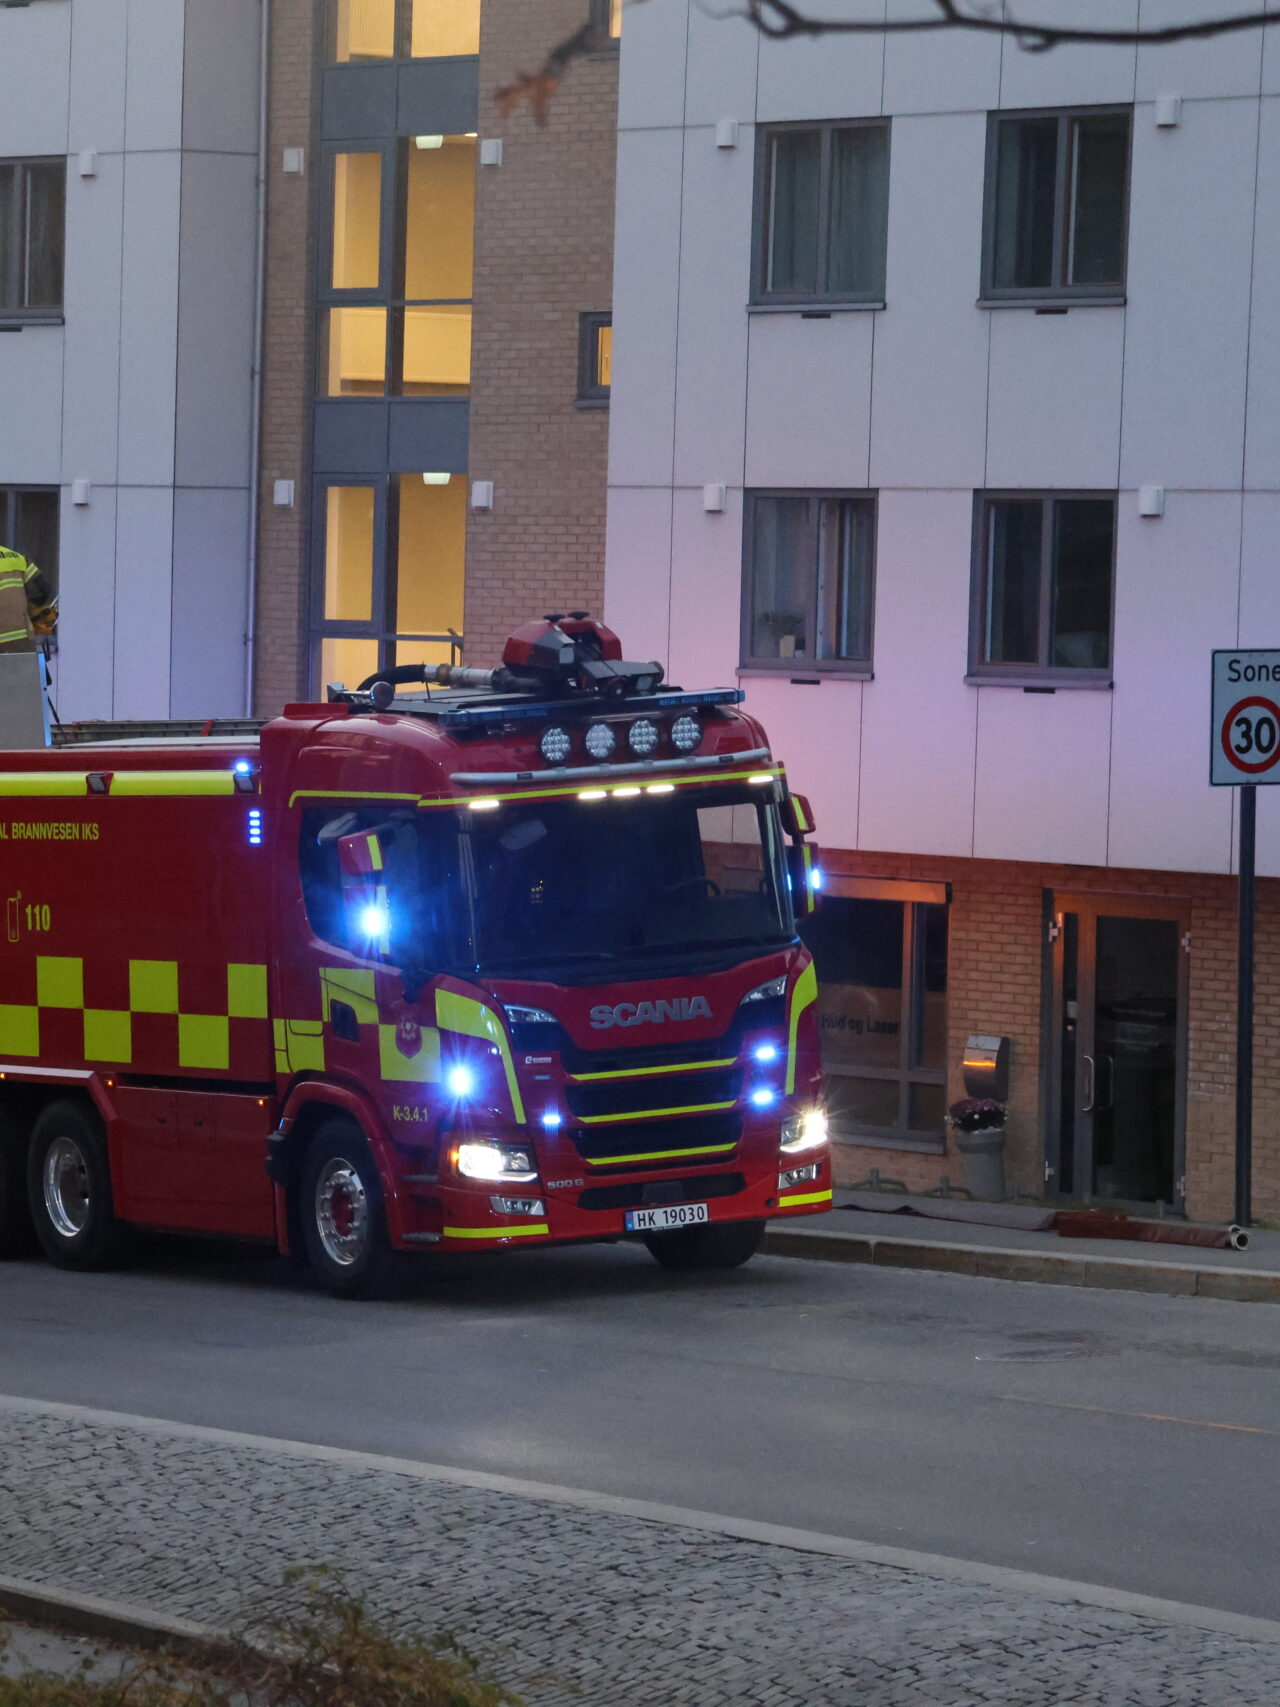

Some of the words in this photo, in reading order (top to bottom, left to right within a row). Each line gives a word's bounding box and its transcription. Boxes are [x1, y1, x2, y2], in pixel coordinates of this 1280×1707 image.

[1228, 659, 1280, 683] Sone
[1234, 717, 1276, 754] 30
[11, 822, 80, 840] BRANNVESEN
[82, 823, 99, 840] IKS
[25, 903, 51, 931] 110
[589, 995, 713, 1030] SCANIA
[848, 1018, 864, 1036] og
[393, 1105, 428, 1122] K-3.4.1
[547, 1179, 573, 1189] 500
[637, 1211, 657, 1228] HK
[662, 1206, 705, 1225] 19030
